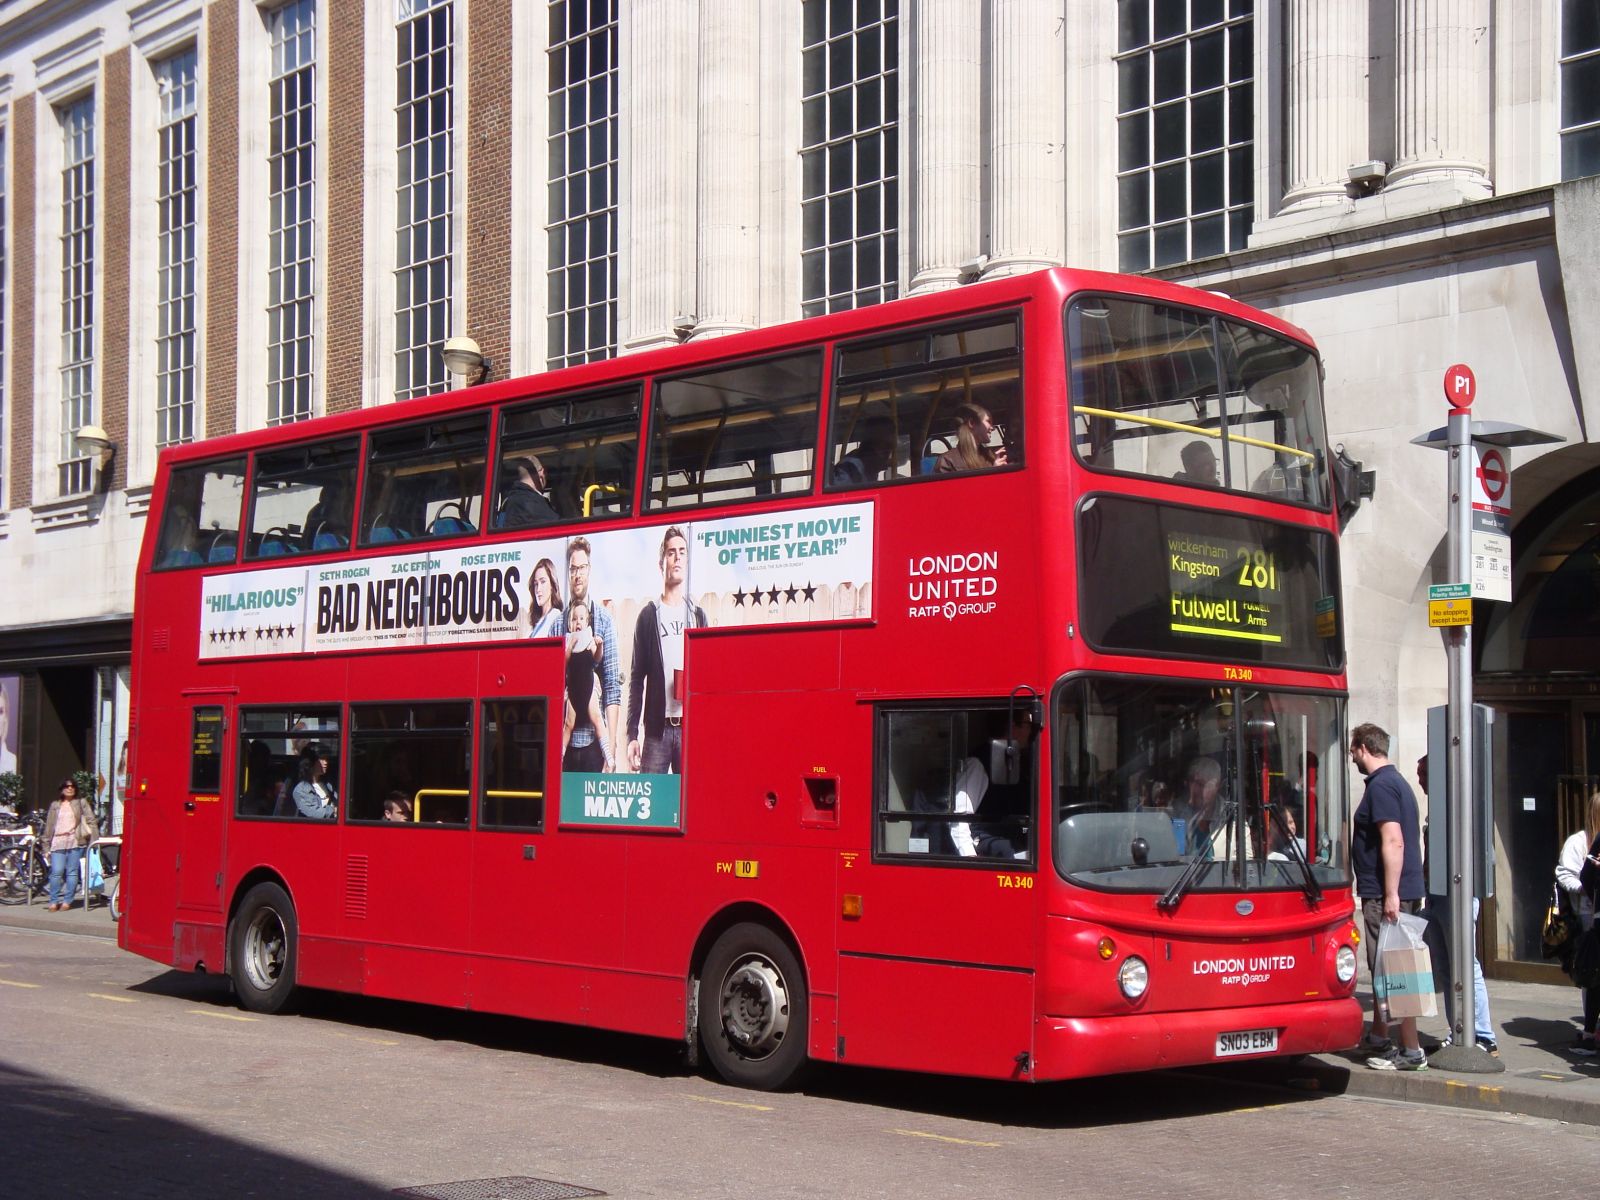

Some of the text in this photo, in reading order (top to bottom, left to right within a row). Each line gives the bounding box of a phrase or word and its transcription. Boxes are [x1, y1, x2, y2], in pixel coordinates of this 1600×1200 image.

[1455, 375, 1469, 395] P1
[697, 516, 861, 547] “FUNNIEST MOVIE
[461, 551, 521, 566] ROSE BYRNE
[718, 537, 847, 566] OF THE YEAR!”
[1168, 539, 1228, 559] wickenham
[391, 560, 441, 573] ZAC EFRON
[909, 551, 998, 576] LONDON
[1171, 554, 1220, 578] Kingston
[1237, 547, 1275, 590] 281
[320, 567, 370, 581] SETH ROGEN
[909, 577, 998, 601] UNITED
[206, 586, 304, 613] “HILARIOUS”
[317, 566, 521, 634] BAD NEIGHBOURS
[1171, 592, 1240, 623] Fulwell
[909, 602, 996, 618] RATP GROUP
[1443, 609, 1469, 617] stopping
[1247, 614, 1268, 627] Arms
[1224, 667, 1252, 680] TA 340
[584, 780, 652, 796] IN CINEMAS
[584, 795, 634, 818] MAY
[636, 796, 651, 819] 3
[716, 861, 751, 874] FW 10
[996, 875, 1033, 889] TA 340
[1193, 956, 1296, 975] LONDON UNITED
[1222, 974, 1271, 985] RATP GROUP
[1220, 1031, 1274, 1052] SN03 EBM
